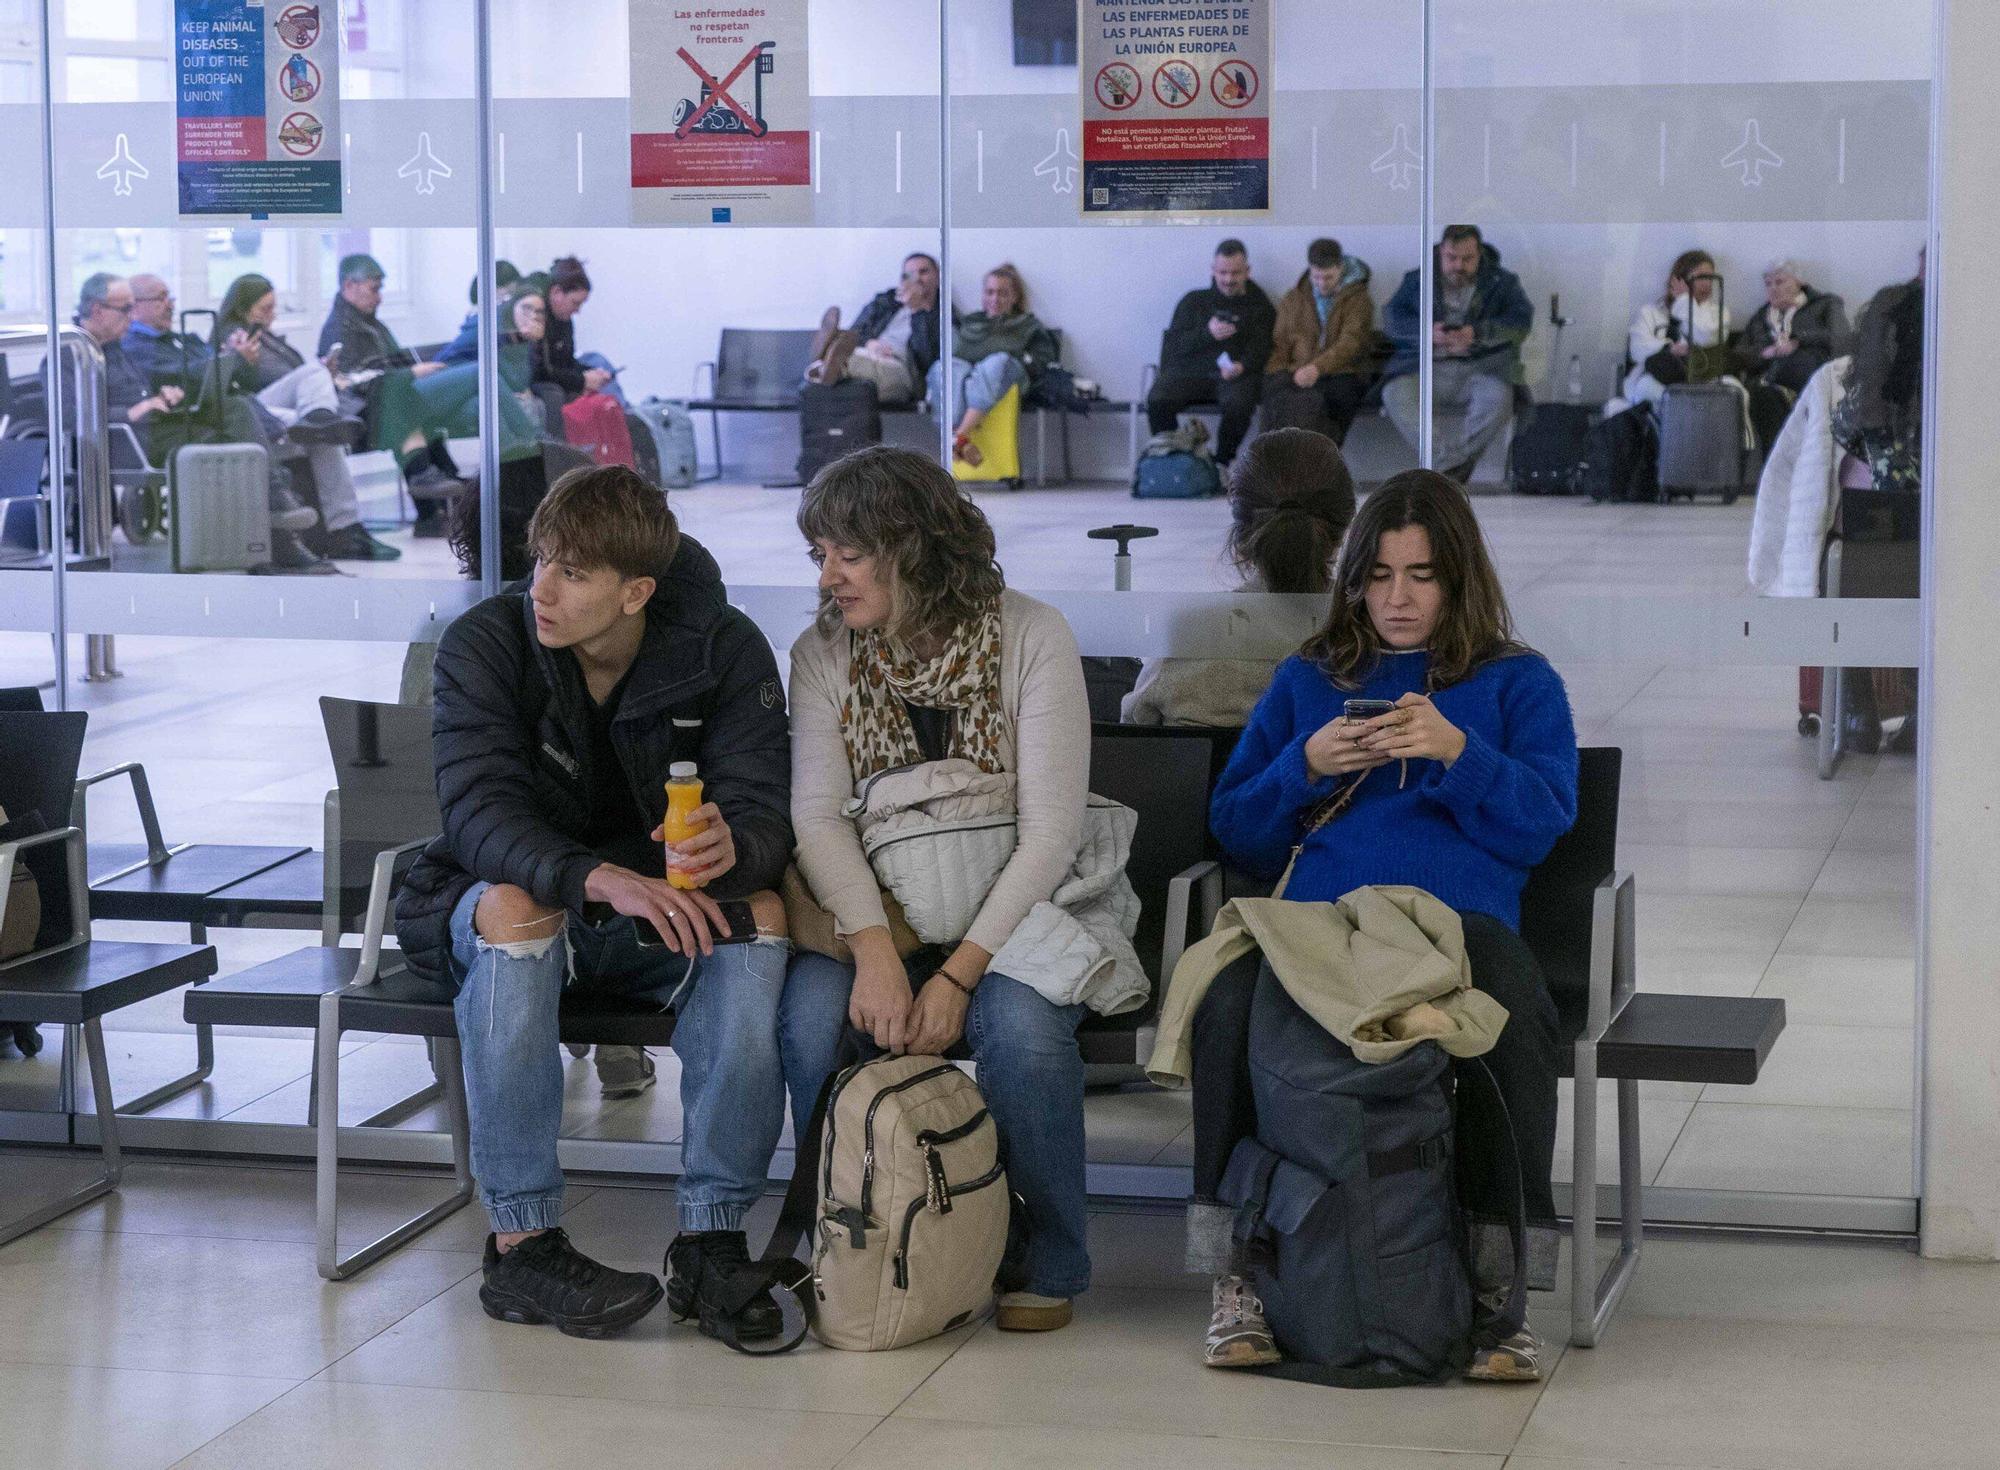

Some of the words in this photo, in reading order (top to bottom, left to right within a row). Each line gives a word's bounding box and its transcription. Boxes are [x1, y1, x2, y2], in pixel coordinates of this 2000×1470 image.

[674, 10, 692, 19] Las
[694, 8, 766, 18] enfermedades
[1103, 12, 1126, 22] LAS
[1130, 9, 1229, 22] ENFERMEDADES
[1233, 9, 1249, 19] DE
[182, 22, 209, 33] KEEP
[211, 21, 256, 33] ANIMAL
[705, 22, 750, 32] respetan
[1103, 28, 1126, 39] LAS
[1130, 27, 1185, 38] PLANTAS
[1188, 26, 1229, 37] FUERA
[1233, 25, 1249, 36] DE
[182, 39, 238, 50] DISEASES
[696, 35, 744, 44] fronteras
[1115, 44, 1131, 55] LA
[1134, 41, 1175, 54] UNIÓN
[1179, 42, 1237, 53] EUROPEA
[183, 56, 205, 68] OUT
[208, 56, 224, 67] OF
[227, 55, 249, 67] THE
[183, 73, 243, 85] EUROPEAN
[183, 91, 223, 102] UNION!
[1114, 127, 1128, 135] está
[1129, 127, 1161, 136] permitido
[1160, 134, 1187, 142] semillas
[1207, 134, 1227, 142] Unión
[1227, 134, 1256, 142] Europea
[1122, 142, 1133, 150] sin
[1144, 142, 1179, 150] certificado
